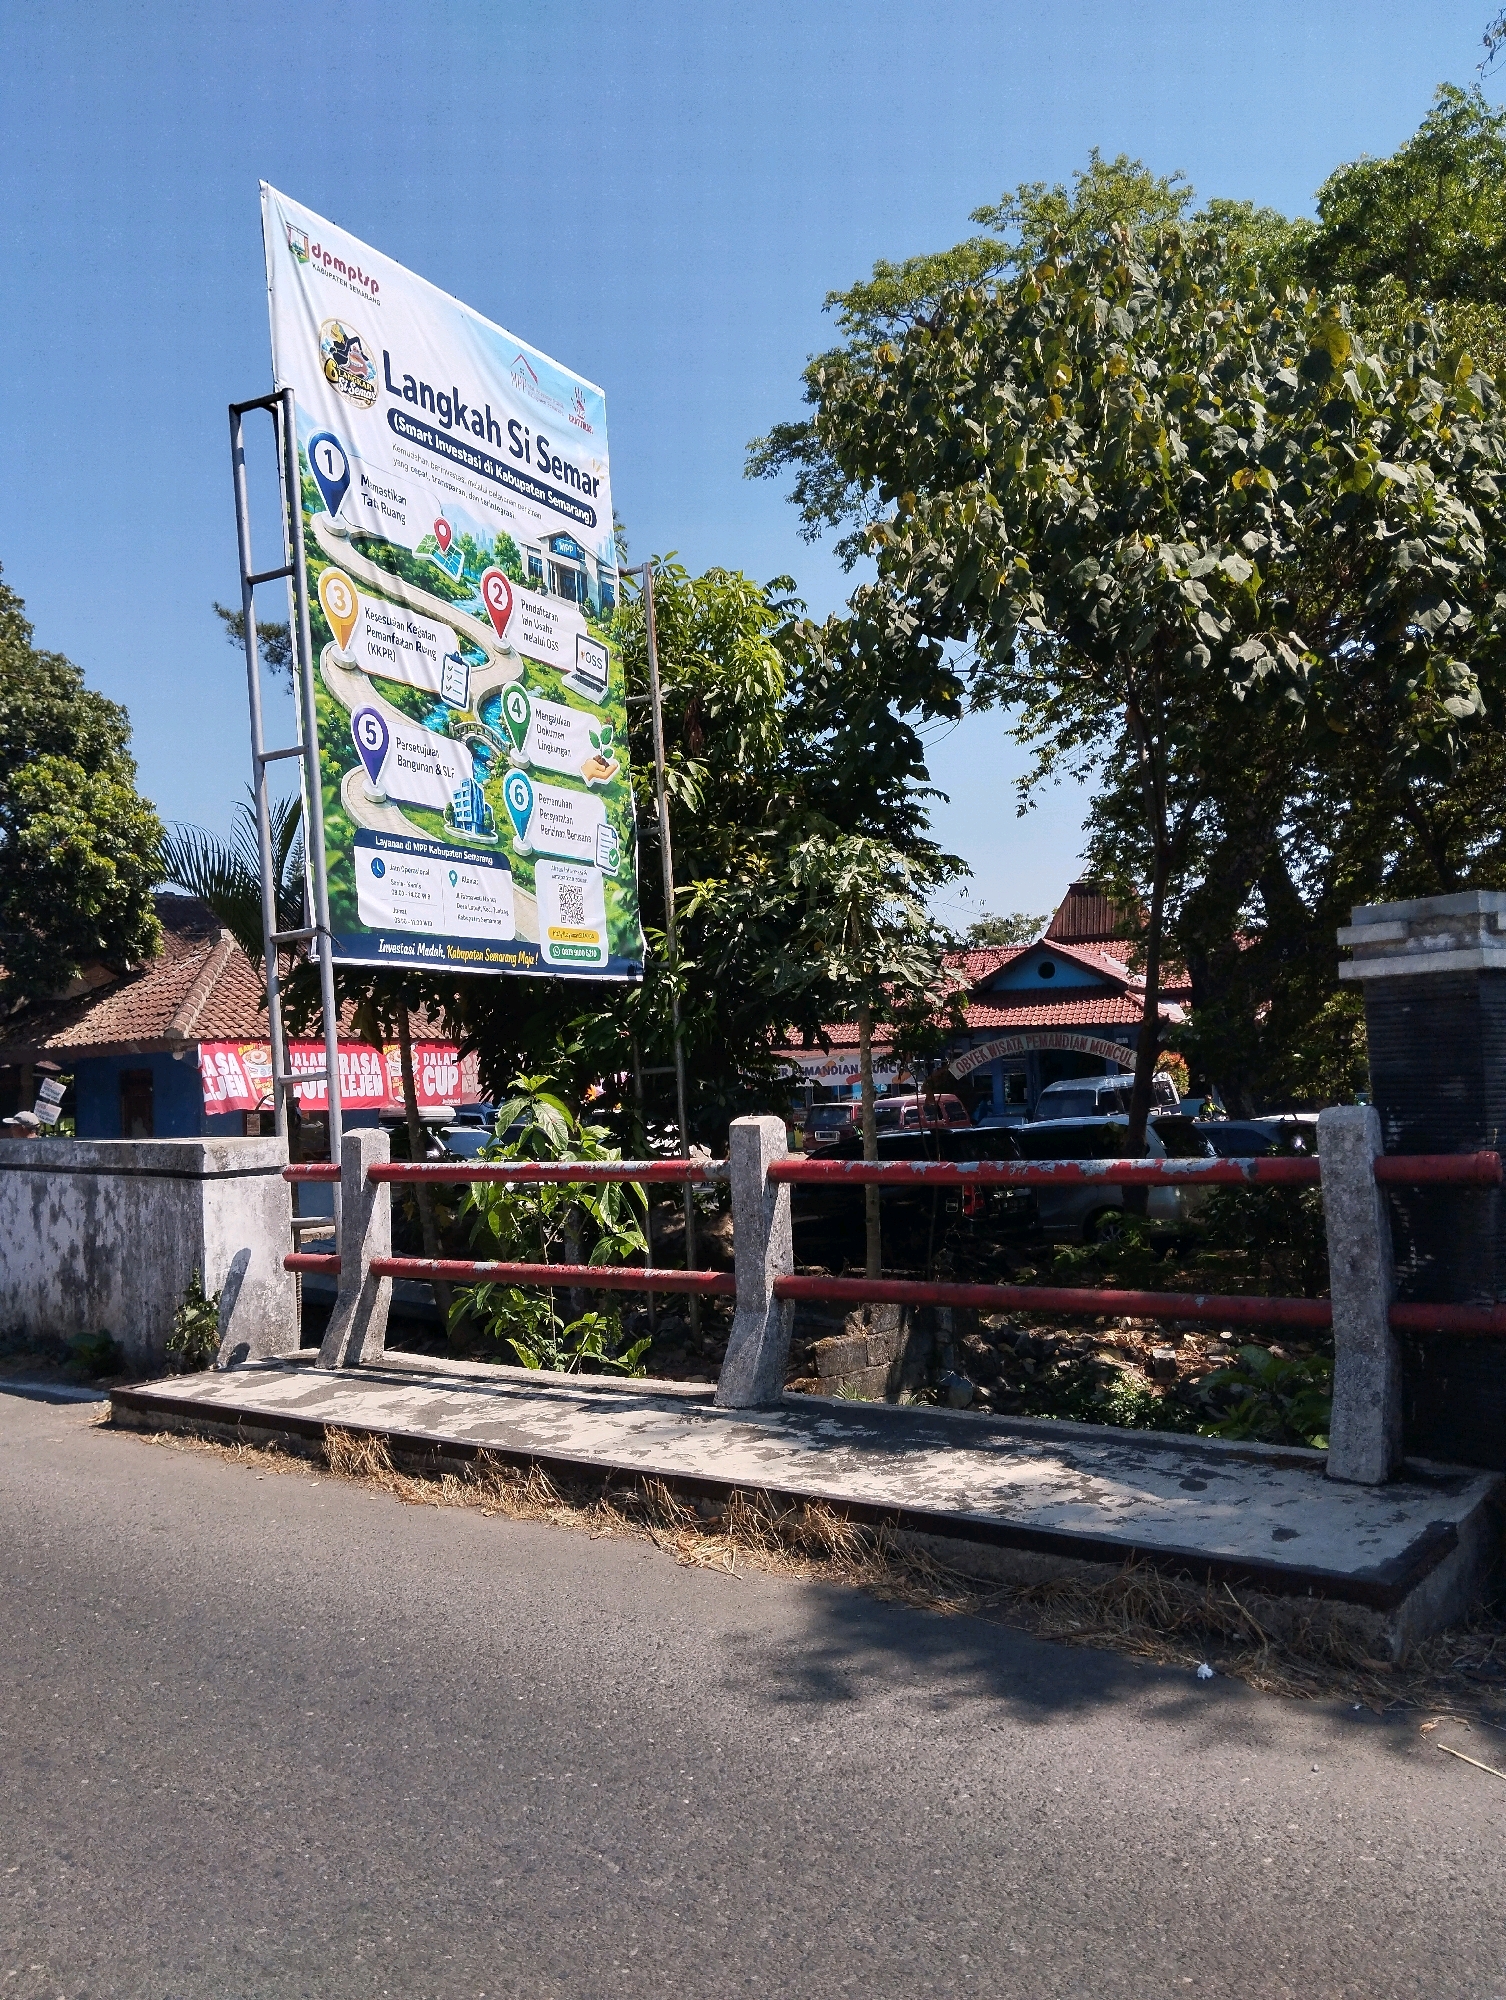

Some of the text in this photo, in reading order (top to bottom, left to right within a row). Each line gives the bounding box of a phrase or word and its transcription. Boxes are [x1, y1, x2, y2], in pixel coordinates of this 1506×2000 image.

[312, 261, 381, 306] KABUPATEN SEMARANG
[324, 357, 339, 383] 6
[382, 349, 501, 448] Langkah
[508, 418, 530, 464] Si
[536, 435, 600, 499] Semar
[324, 449, 333, 475] 1
[393, 458, 409, 473] yang
[394, 413, 593, 525] (Smart Investasi di Kabupaten Semarang)
[381, 501, 406, 526] Ruang
[333, 585, 346, 611] 3
[493, 582, 503, 606] 2
[367, 641, 396, 663] (KKPR)
[585, 651, 603, 670] OSS
[511, 697, 522, 718] 4
[365, 720, 376, 745] 5
[396, 736, 440, 759] Persetujuan
[397, 754, 434, 774] Bangunan
[435, 763, 442, 776] &
[514, 783, 525, 806] 6
[375, 835, 493, 866] Layanan di MPP Kabupaten Semarang
[378, 938, 416, 956] Investasi
[446, 945, 484, 964] Kabupaten
[484, 948, 517, 967] Semarang
[338, 1052, 382, 1075] RASA
[423, 1052, 459, 1066] DALAM
[956, 1033, 1132, 1074] OBYEK WISATA PEMANDIAN MUNCUL
[340, 1074, 384, 1097] LEJEN
[423, 1065, 459, 1096] CUP
